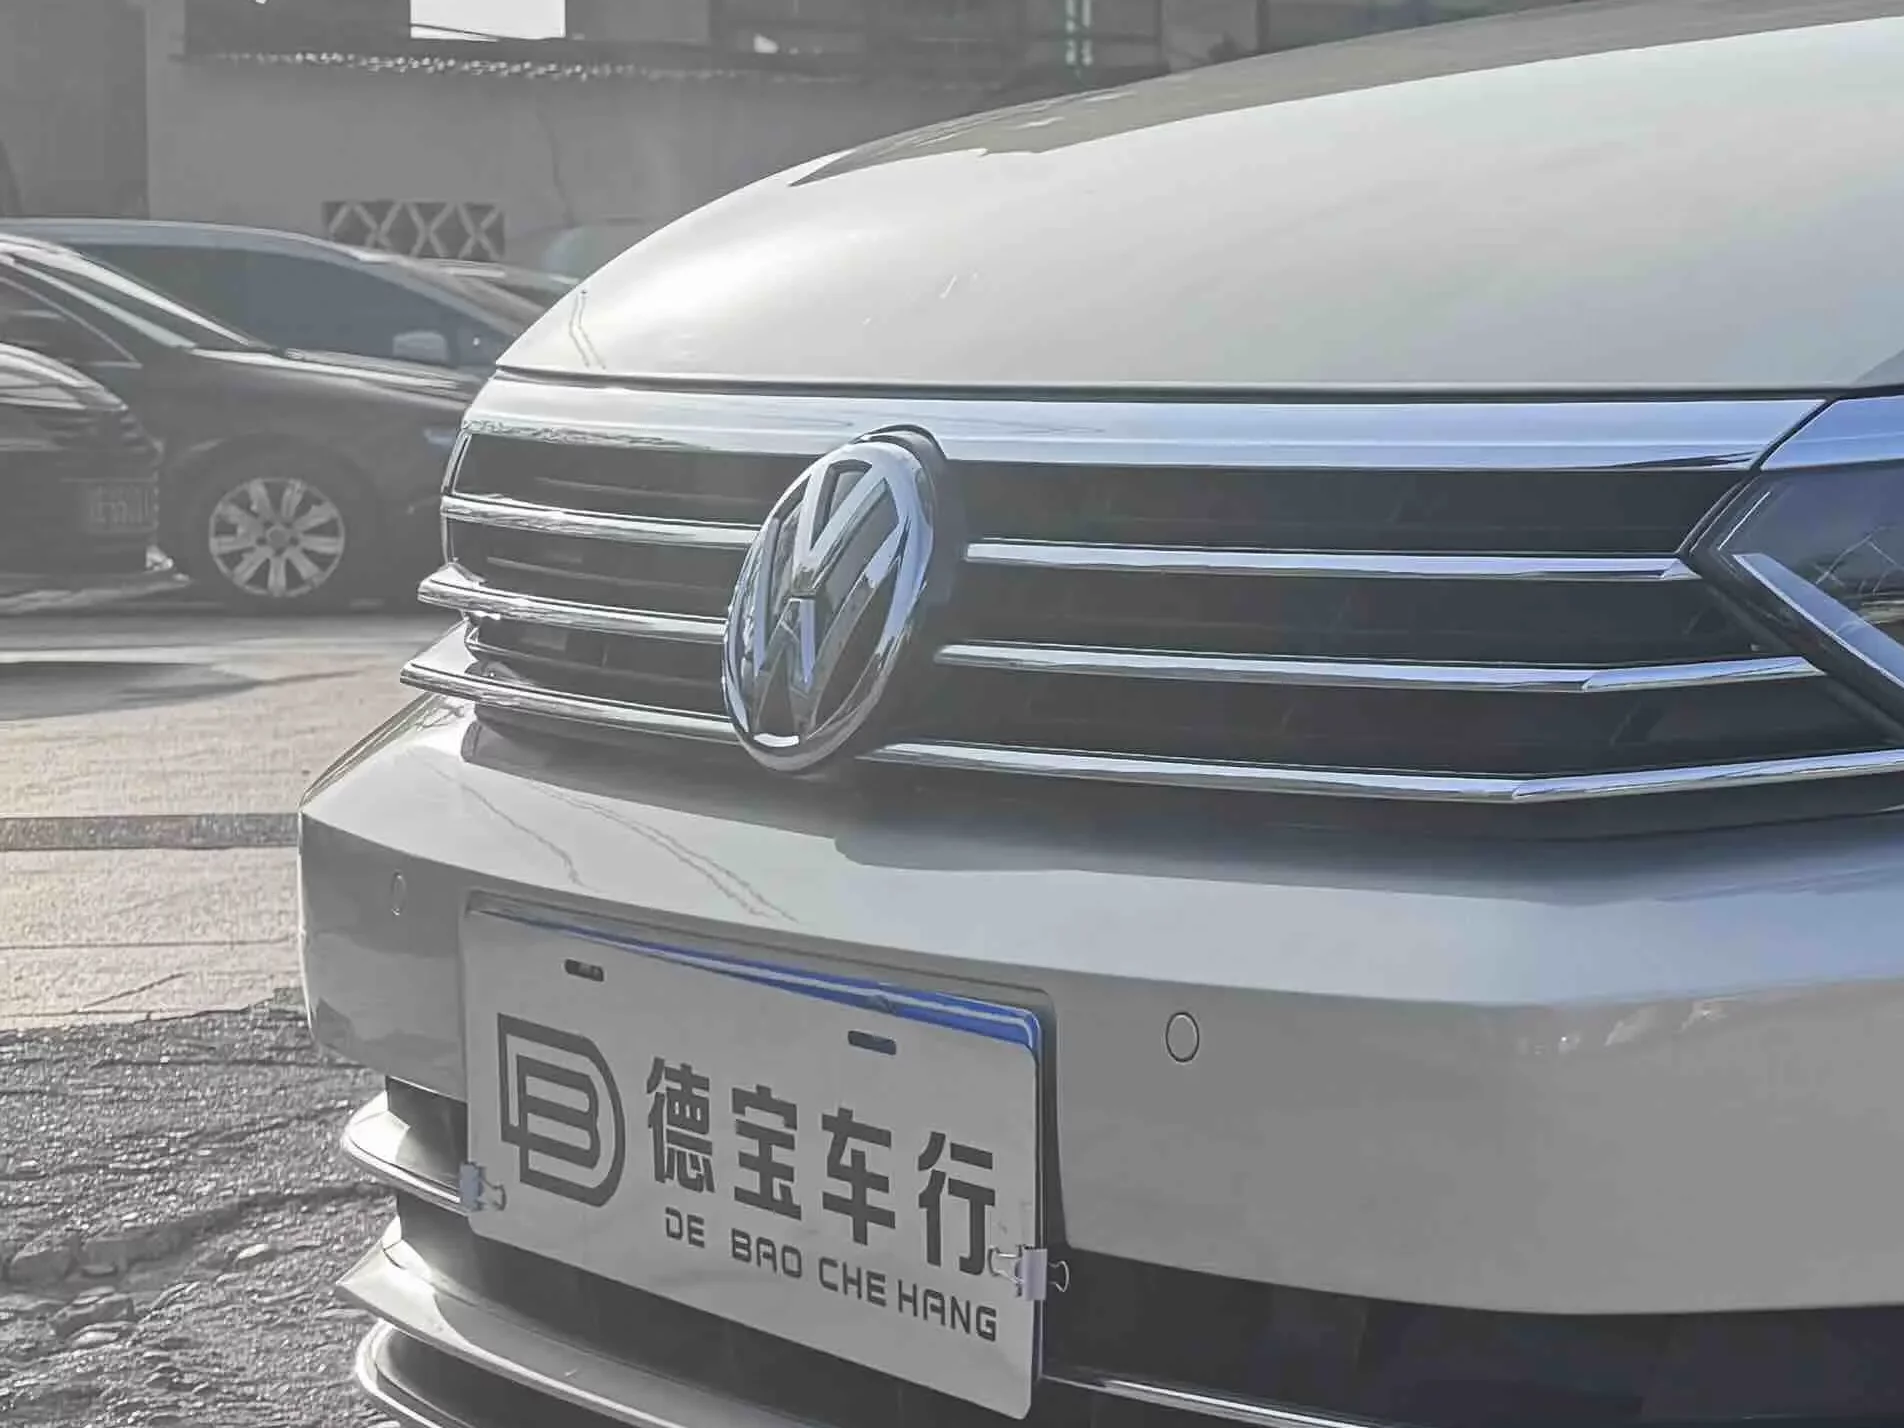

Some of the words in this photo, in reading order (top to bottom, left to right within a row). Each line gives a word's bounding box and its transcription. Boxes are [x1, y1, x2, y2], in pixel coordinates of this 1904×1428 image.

[645, 1055, 997, 1276] 德宝车行
[664, 1206, 706, 1248] DE
[730, 1235, 802, 1279] BAO
[818, 1257, 886, 1308] CHE
[897, 1280, 997, 1342] HANG
